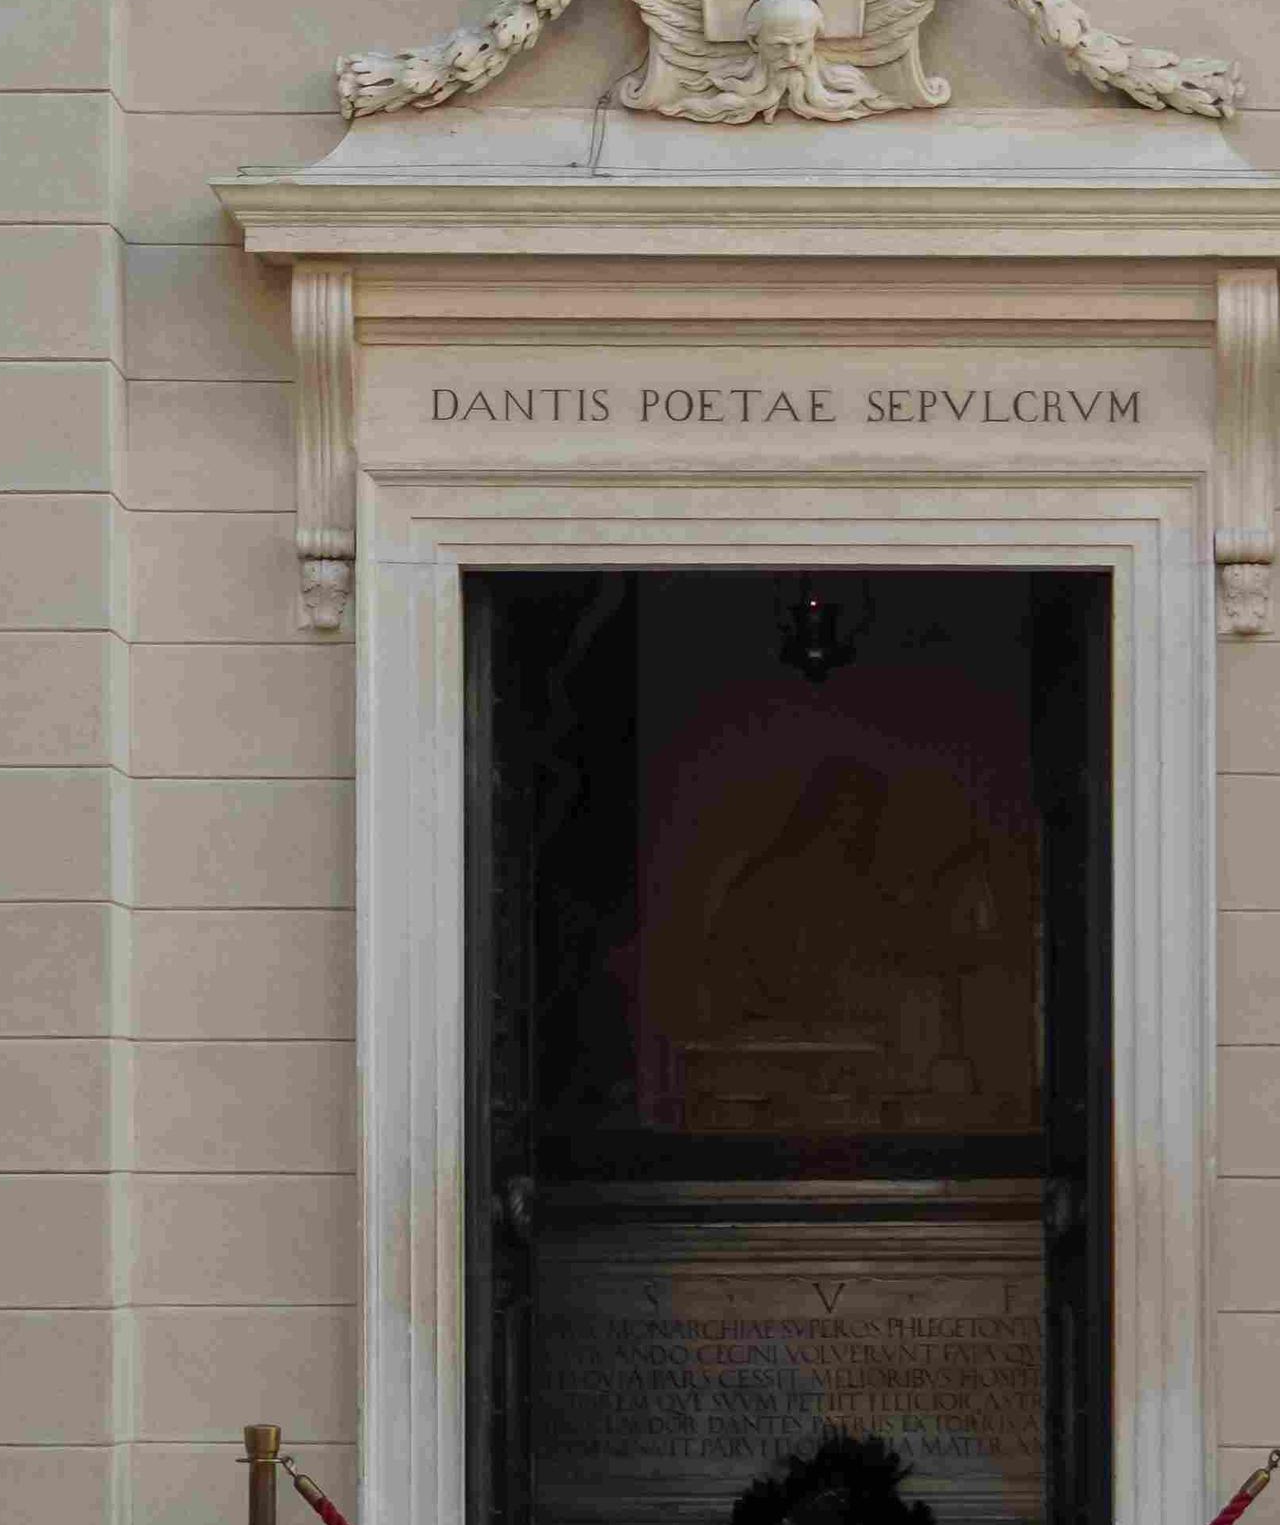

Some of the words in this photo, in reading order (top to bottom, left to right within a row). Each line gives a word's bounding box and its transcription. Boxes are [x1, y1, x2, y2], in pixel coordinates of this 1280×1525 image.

[431, 388, 611, 423] DANTIS
[639, 388, 837, 423] POETAE
[867, 388, 1142, 423] SEPVLCRVM
[811, 1283, 846, 1313] V
